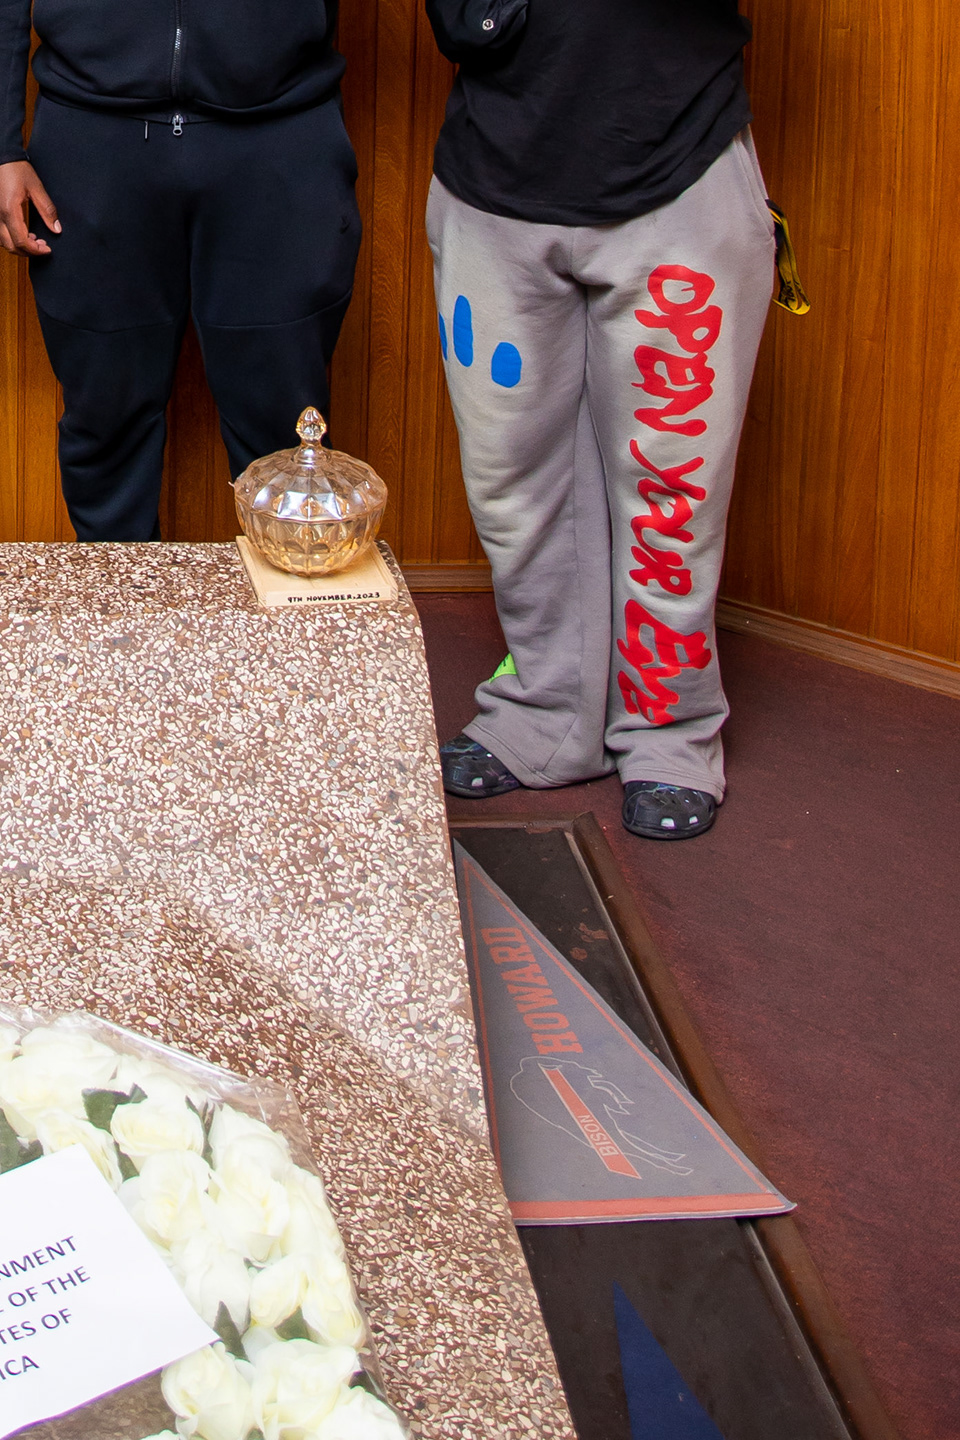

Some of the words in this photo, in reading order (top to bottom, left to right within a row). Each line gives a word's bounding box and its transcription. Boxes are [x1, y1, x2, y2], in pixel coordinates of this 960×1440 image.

[631, 264, 723, 436] OPEN
[628, 439, 707, 596] YOUR
[481, 927, 584, 1055] HOWARD
[578, 1114, 619, 1157] BISON
[7, 1286, 39, 1307] OF
[42, 1265, 91, 1295] THE
[41, 1308, 73, 1331] OF
